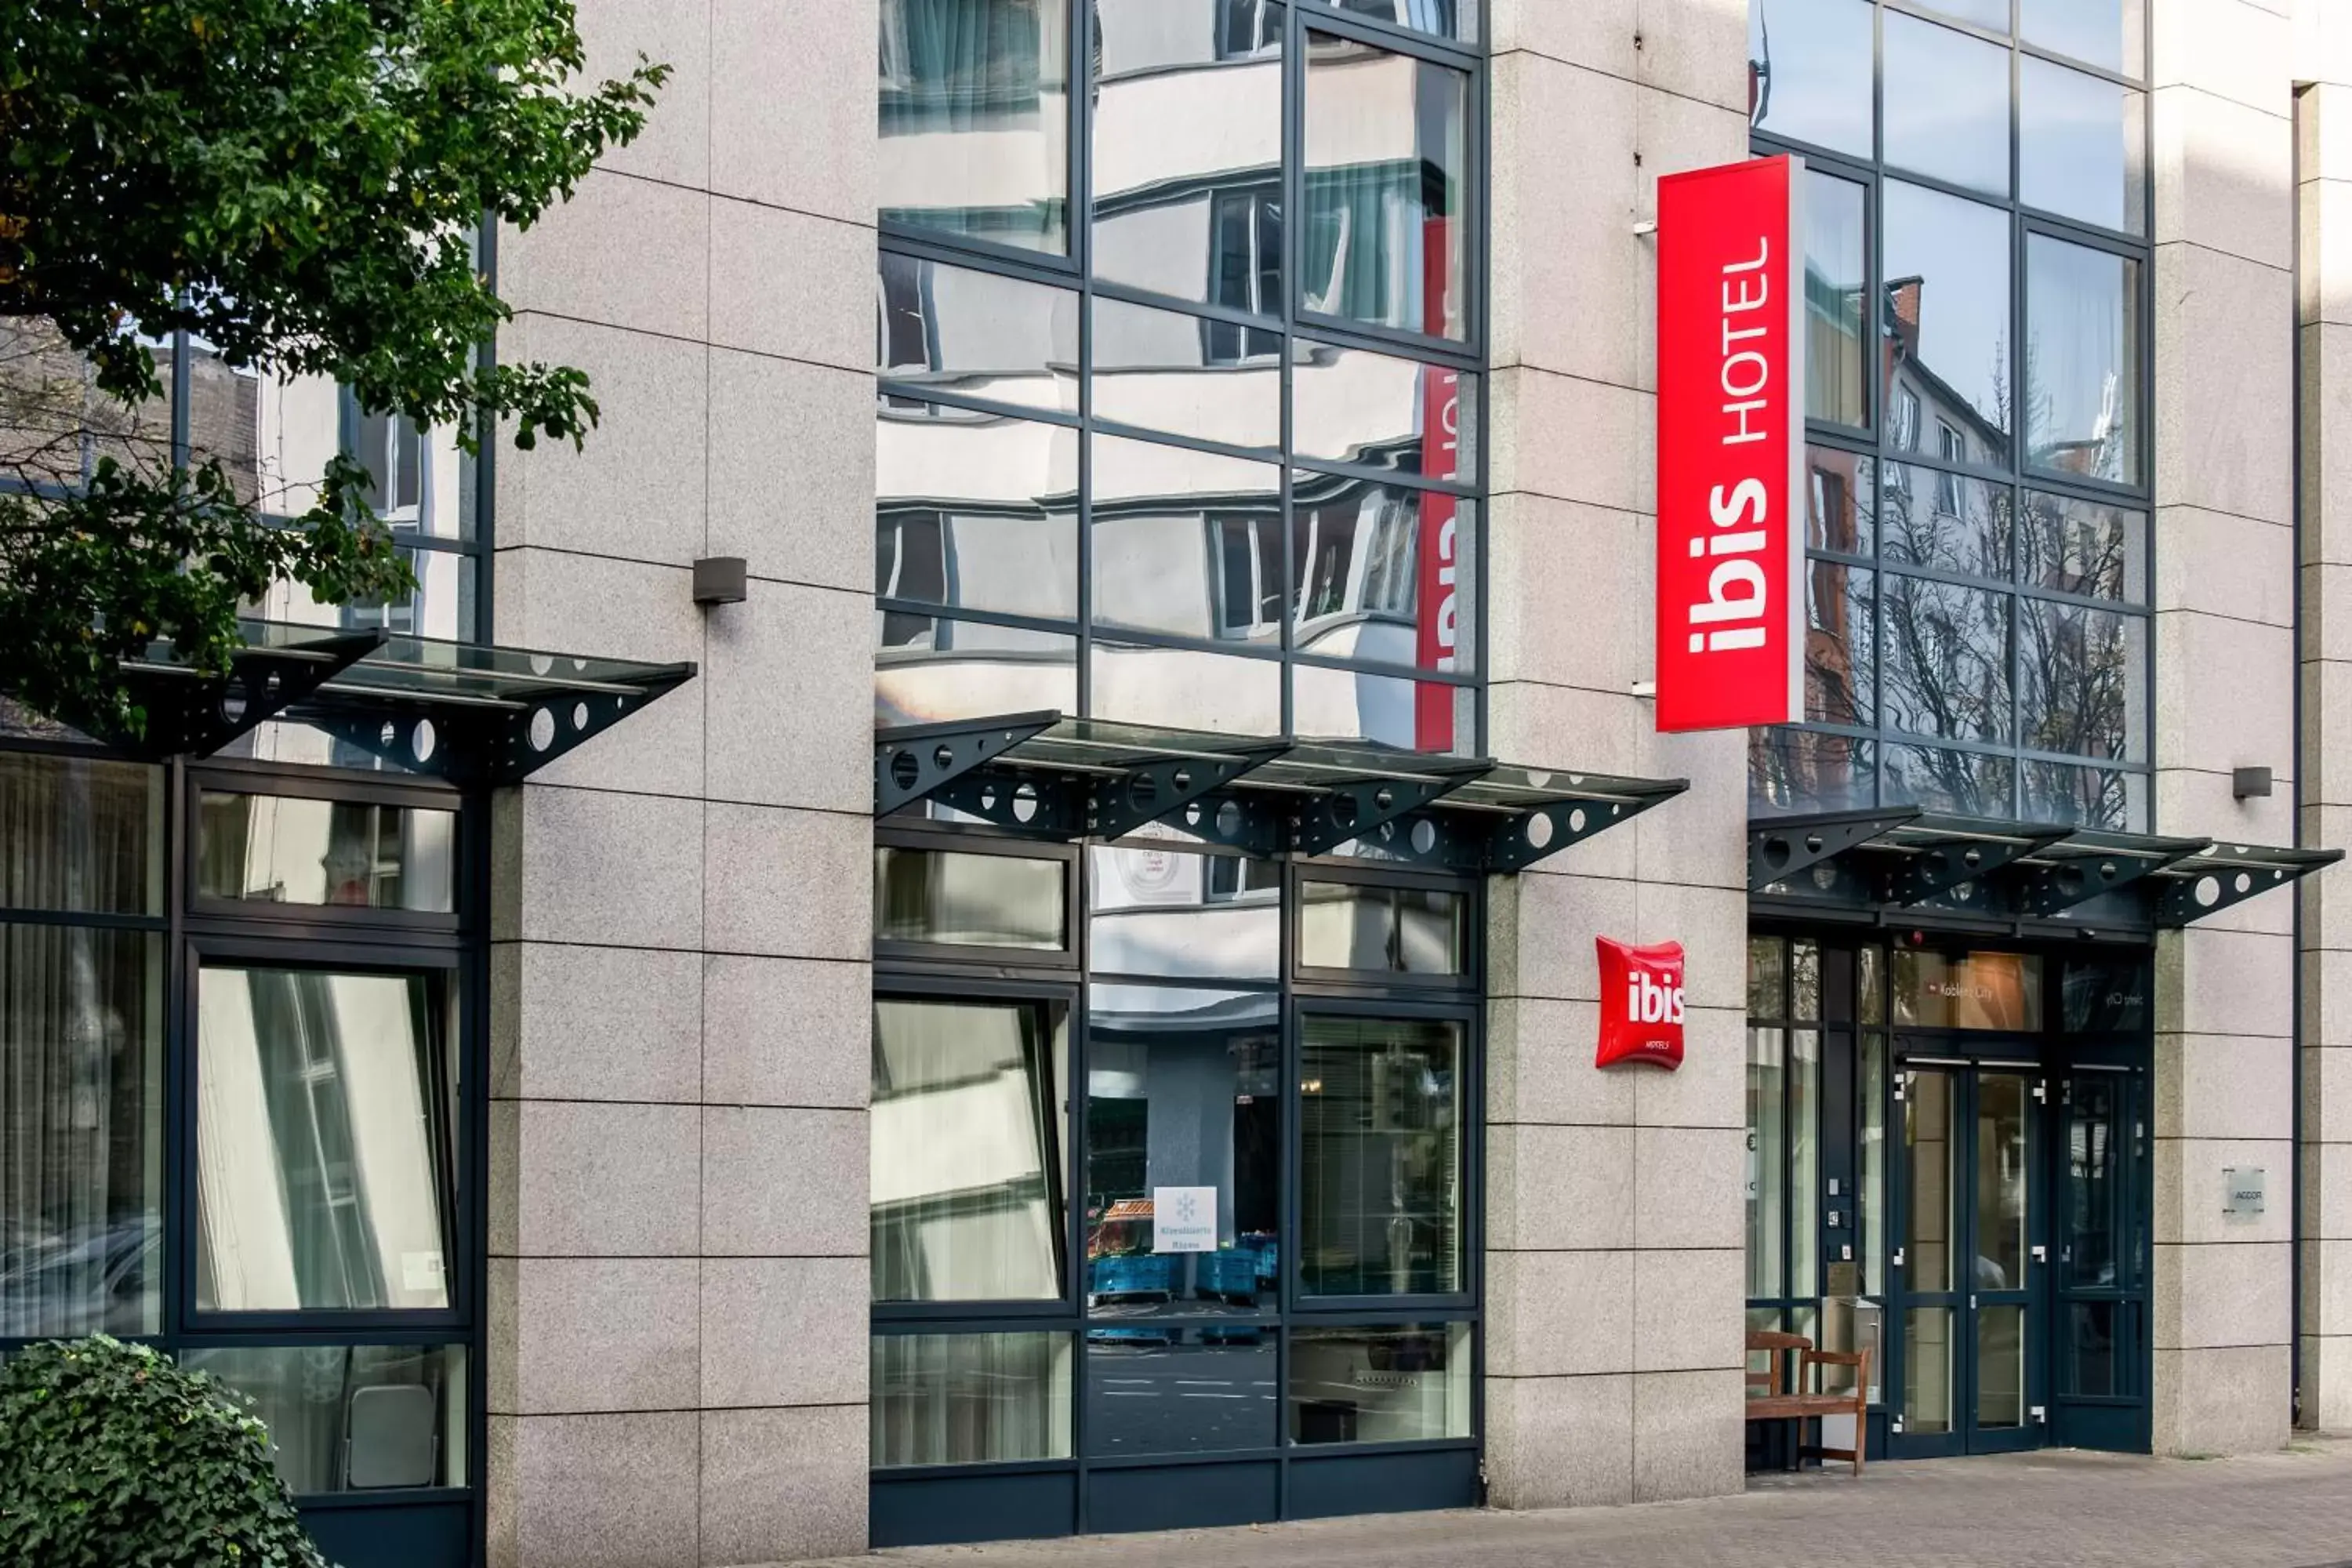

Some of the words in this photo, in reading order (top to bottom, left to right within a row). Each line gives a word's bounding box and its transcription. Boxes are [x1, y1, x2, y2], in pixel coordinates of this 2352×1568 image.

[1722, 236, 1768, 445] HOTEL
[1689, 477, 1767, 653] ibis
[1628, 971, 1684, 1024] ibis
[2235, 1191, 2263, 1200] ACCOR
